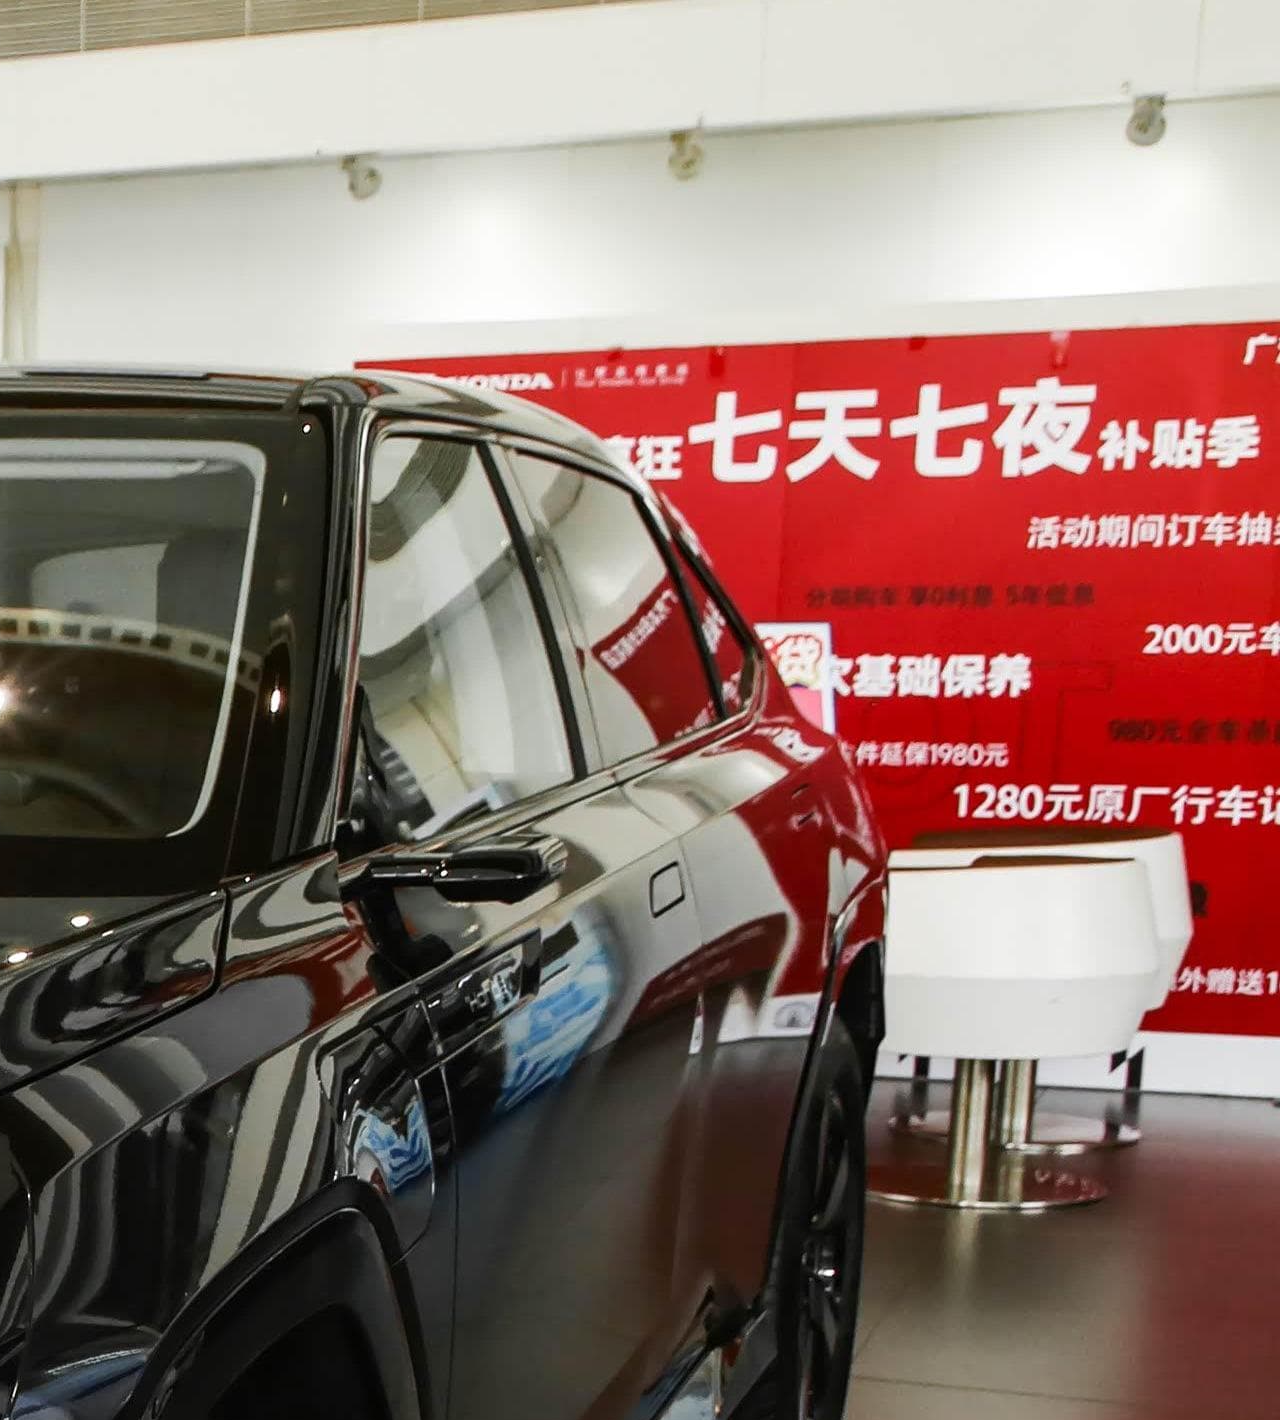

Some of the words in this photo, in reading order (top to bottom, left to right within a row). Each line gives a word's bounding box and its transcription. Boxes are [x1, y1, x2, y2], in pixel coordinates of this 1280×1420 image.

[1243, 333, 1280, 364] 广
[1027, 512, 1280, 548] 活动期间订车抽
[1171, 966, 1280, 996] 外赠送1
